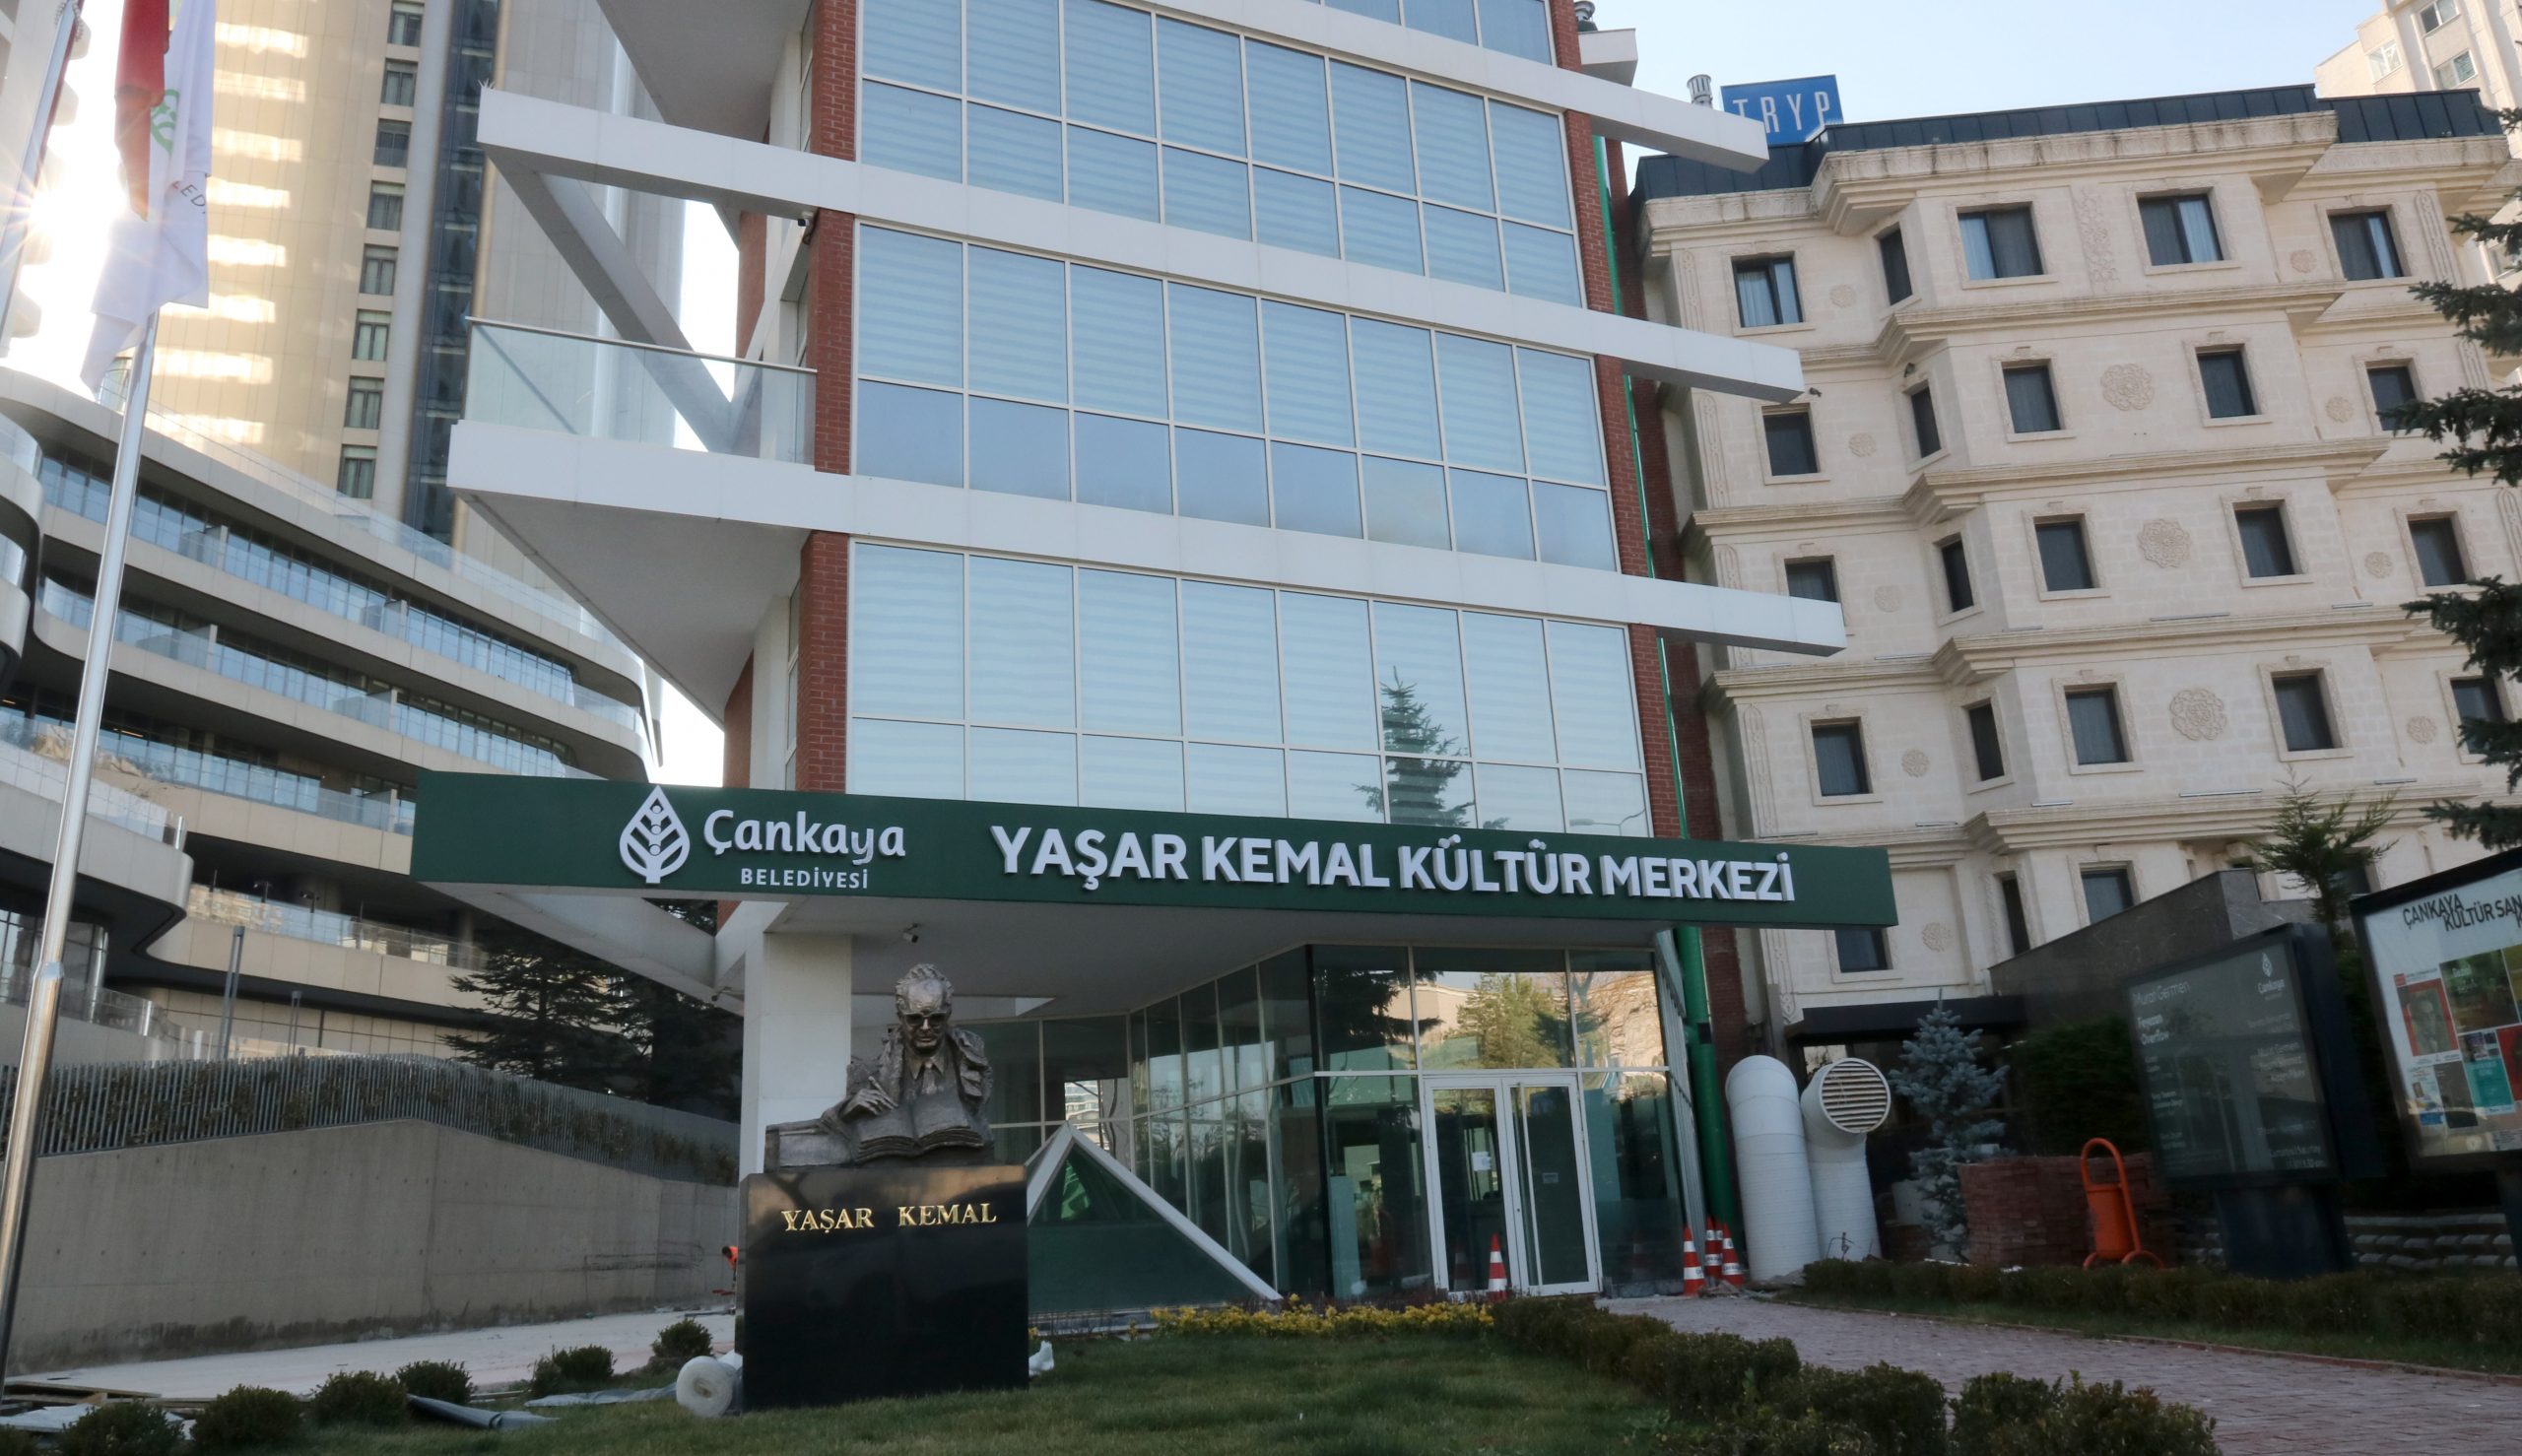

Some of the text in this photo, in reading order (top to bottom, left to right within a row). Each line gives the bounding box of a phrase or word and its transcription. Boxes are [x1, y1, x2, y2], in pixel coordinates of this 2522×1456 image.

[1733, 91, 1830, 134] TRYP
[703, 809, 906, 866] Çankaya
[740, 867, 869, 890] BELEDİYESİ
[990, 825, 1795, 902] YAŞAR KEMAL KÜLTÜR MERKEZİ
[2403, 893, 2465, 930] ÇANKAYA
[781, 1203, 997, 1233] YAŞAR KEMAL
